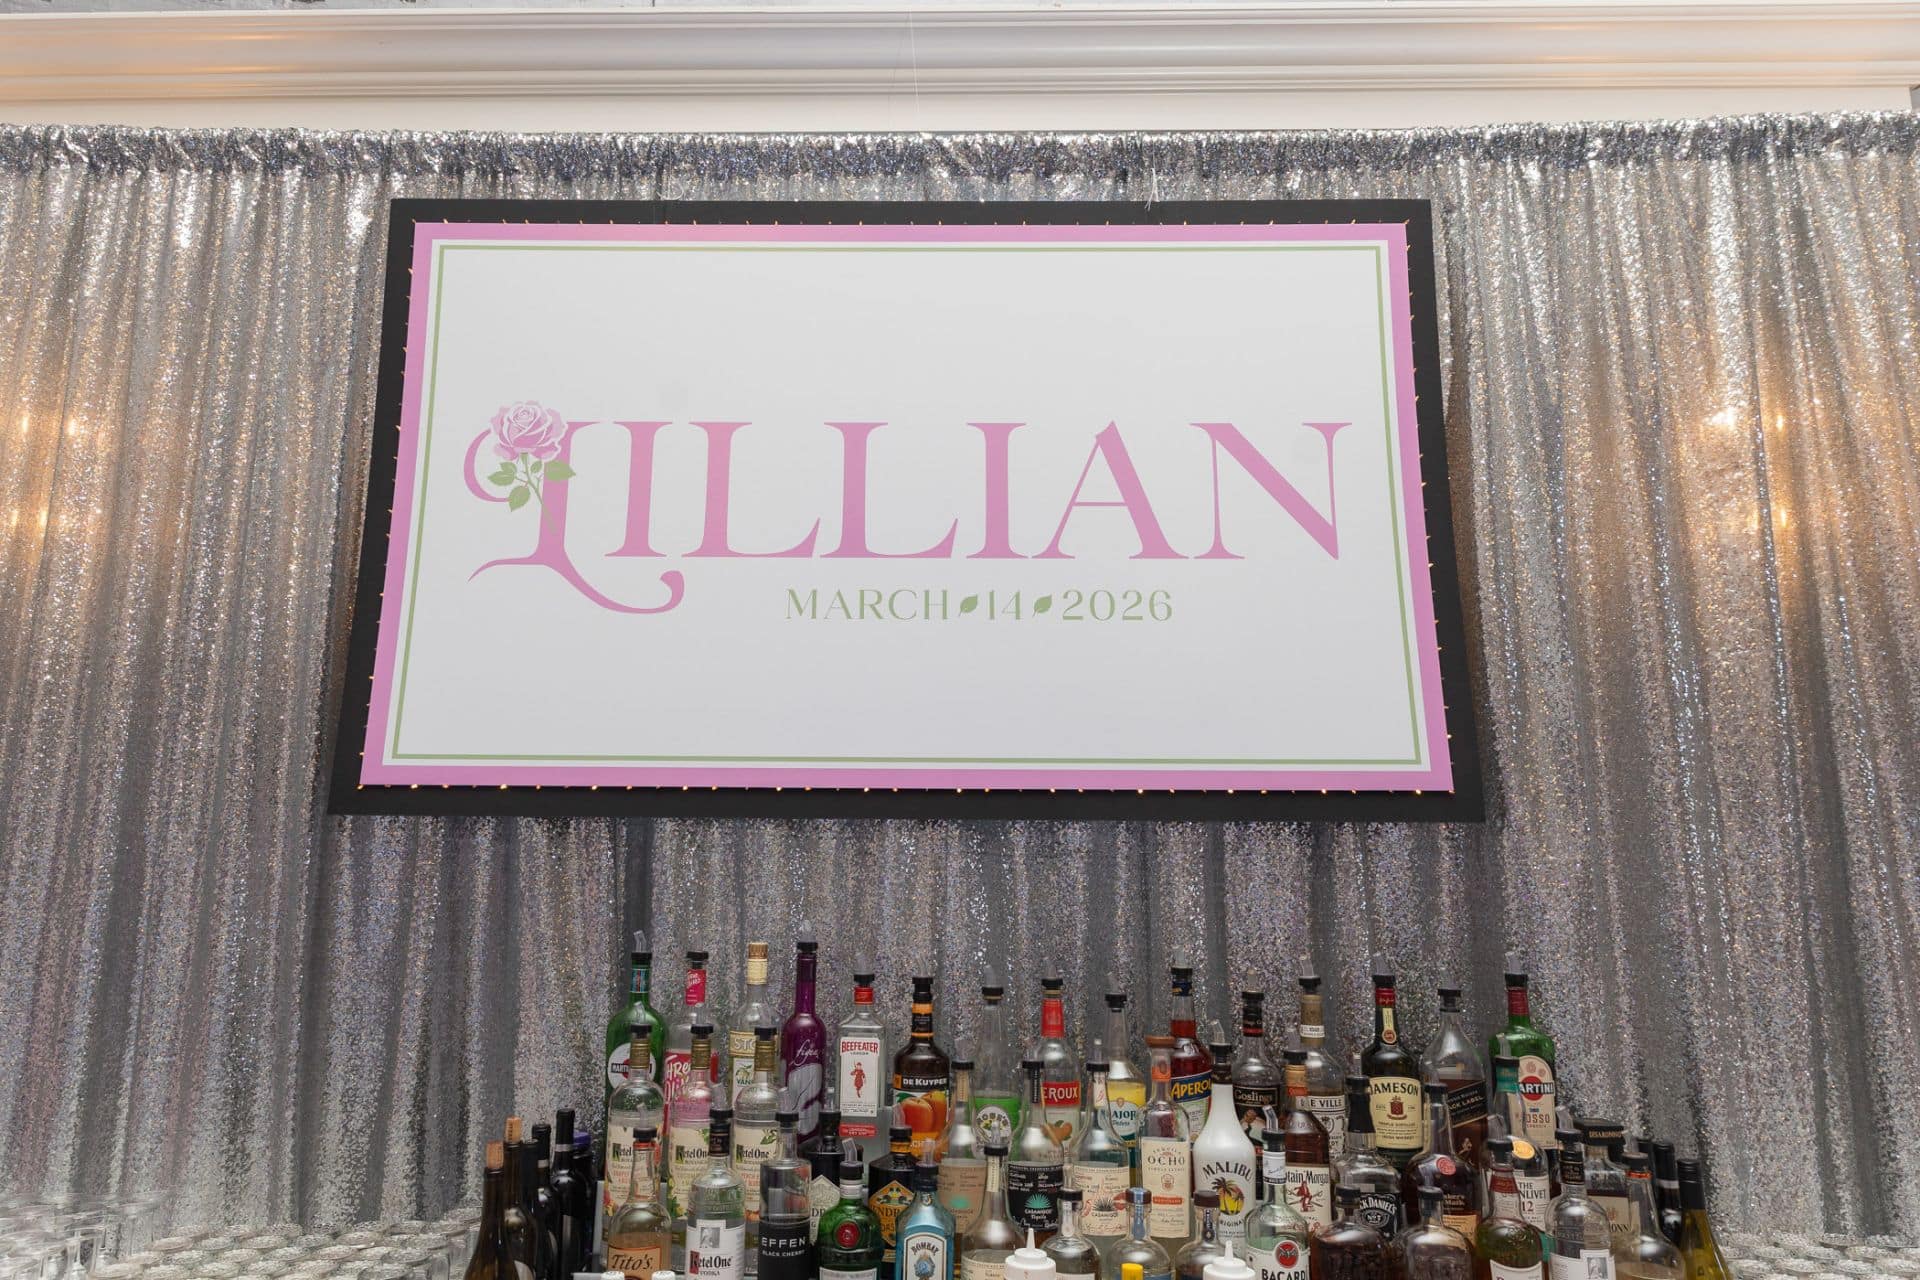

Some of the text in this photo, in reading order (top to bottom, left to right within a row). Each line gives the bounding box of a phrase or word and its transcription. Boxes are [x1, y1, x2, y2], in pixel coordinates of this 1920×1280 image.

[463, 418, 1353, 614] LILLIAN
[786, 589, 1172, 621] MARCH 14 2026
[841, 1041, 879, 1054] BEEFEATER
[902, 1078, 914, 1086] DE
[1369, 1082, 1419, 1096] JAMESON
[754, 1148, 769, 1158] One
[1202, 1161, 1253, 1183] MALIBU
[1521, 1201, 1534, 1212] 12
[761, 1236, 806, 1249] EFFEN
[690, 1250, 732, 1274] Ketel One
